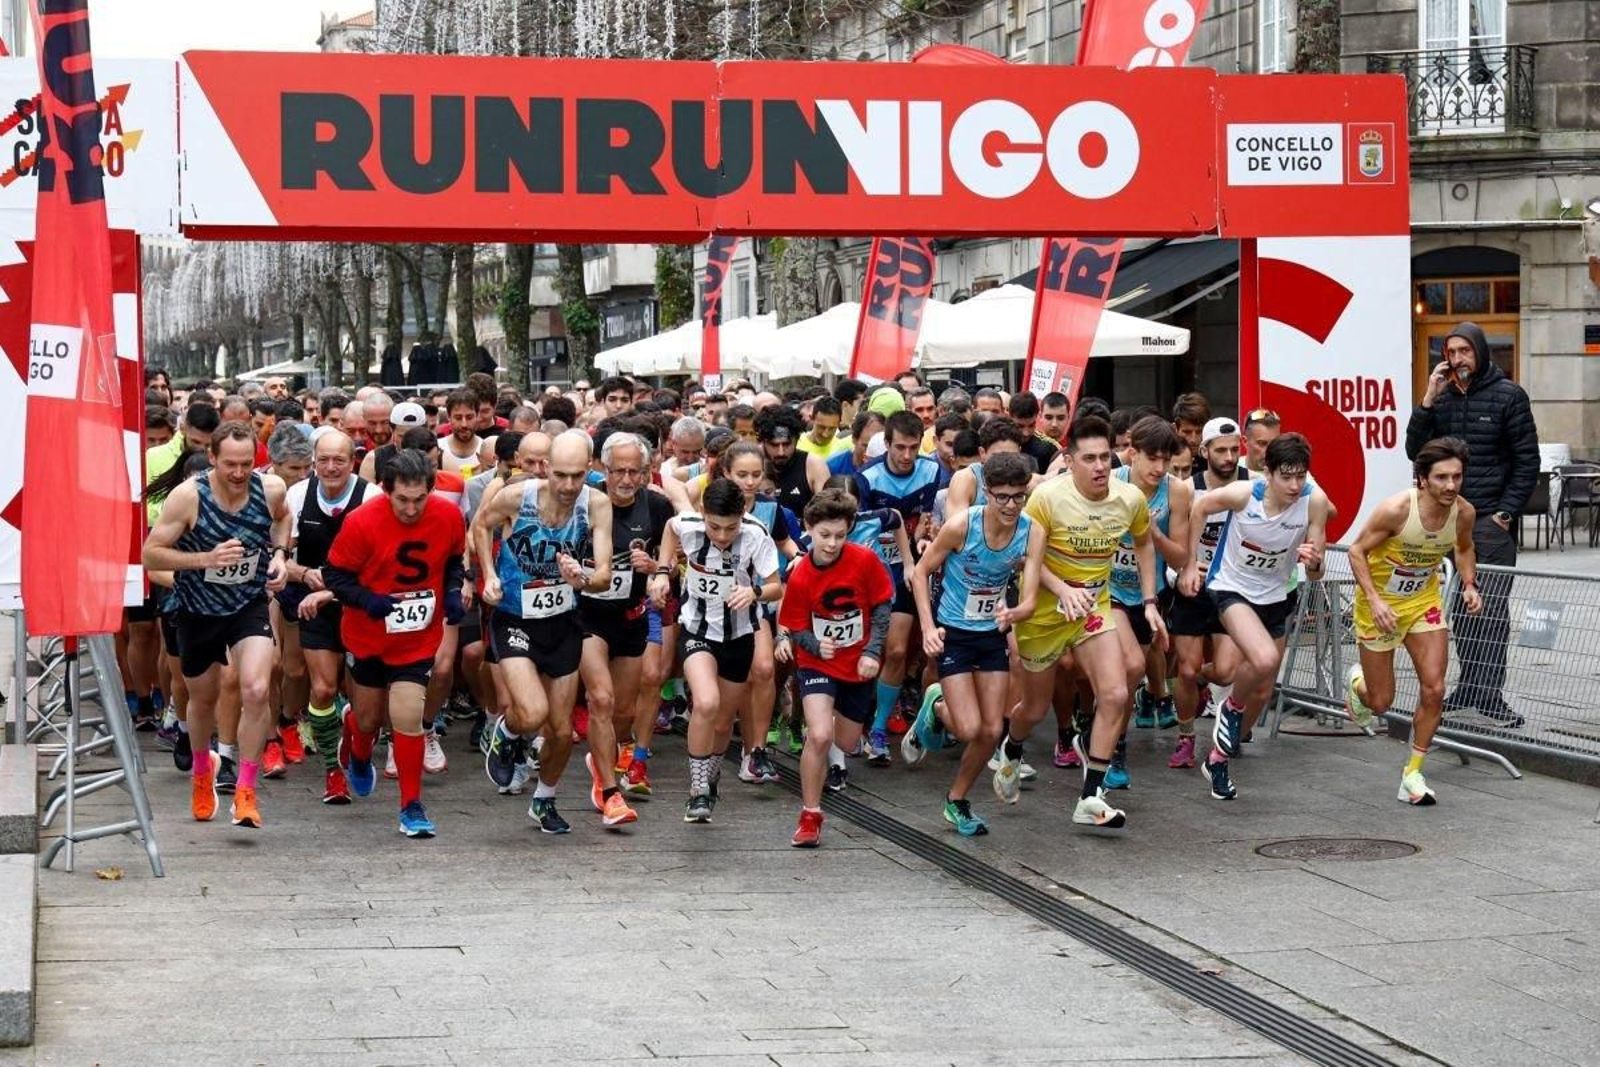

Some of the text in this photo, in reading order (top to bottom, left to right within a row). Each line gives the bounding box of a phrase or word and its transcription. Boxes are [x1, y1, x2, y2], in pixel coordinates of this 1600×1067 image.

[1236, 136, 1333, 152] CONCELLO
[1248, 156, 1323, 172] DE VIGO
[1141, 336, 1176, 346] Mahou
[215, 562, 250, 578] 398
[395, 540, 429, 585] S
[1245, 554, 1278, 569] 272
[698, 577, 719, 596] 32
[532, 590, 564, 610] 436
[395, 604, 428, 624] 349
[823, 623, 854, 641] 427
